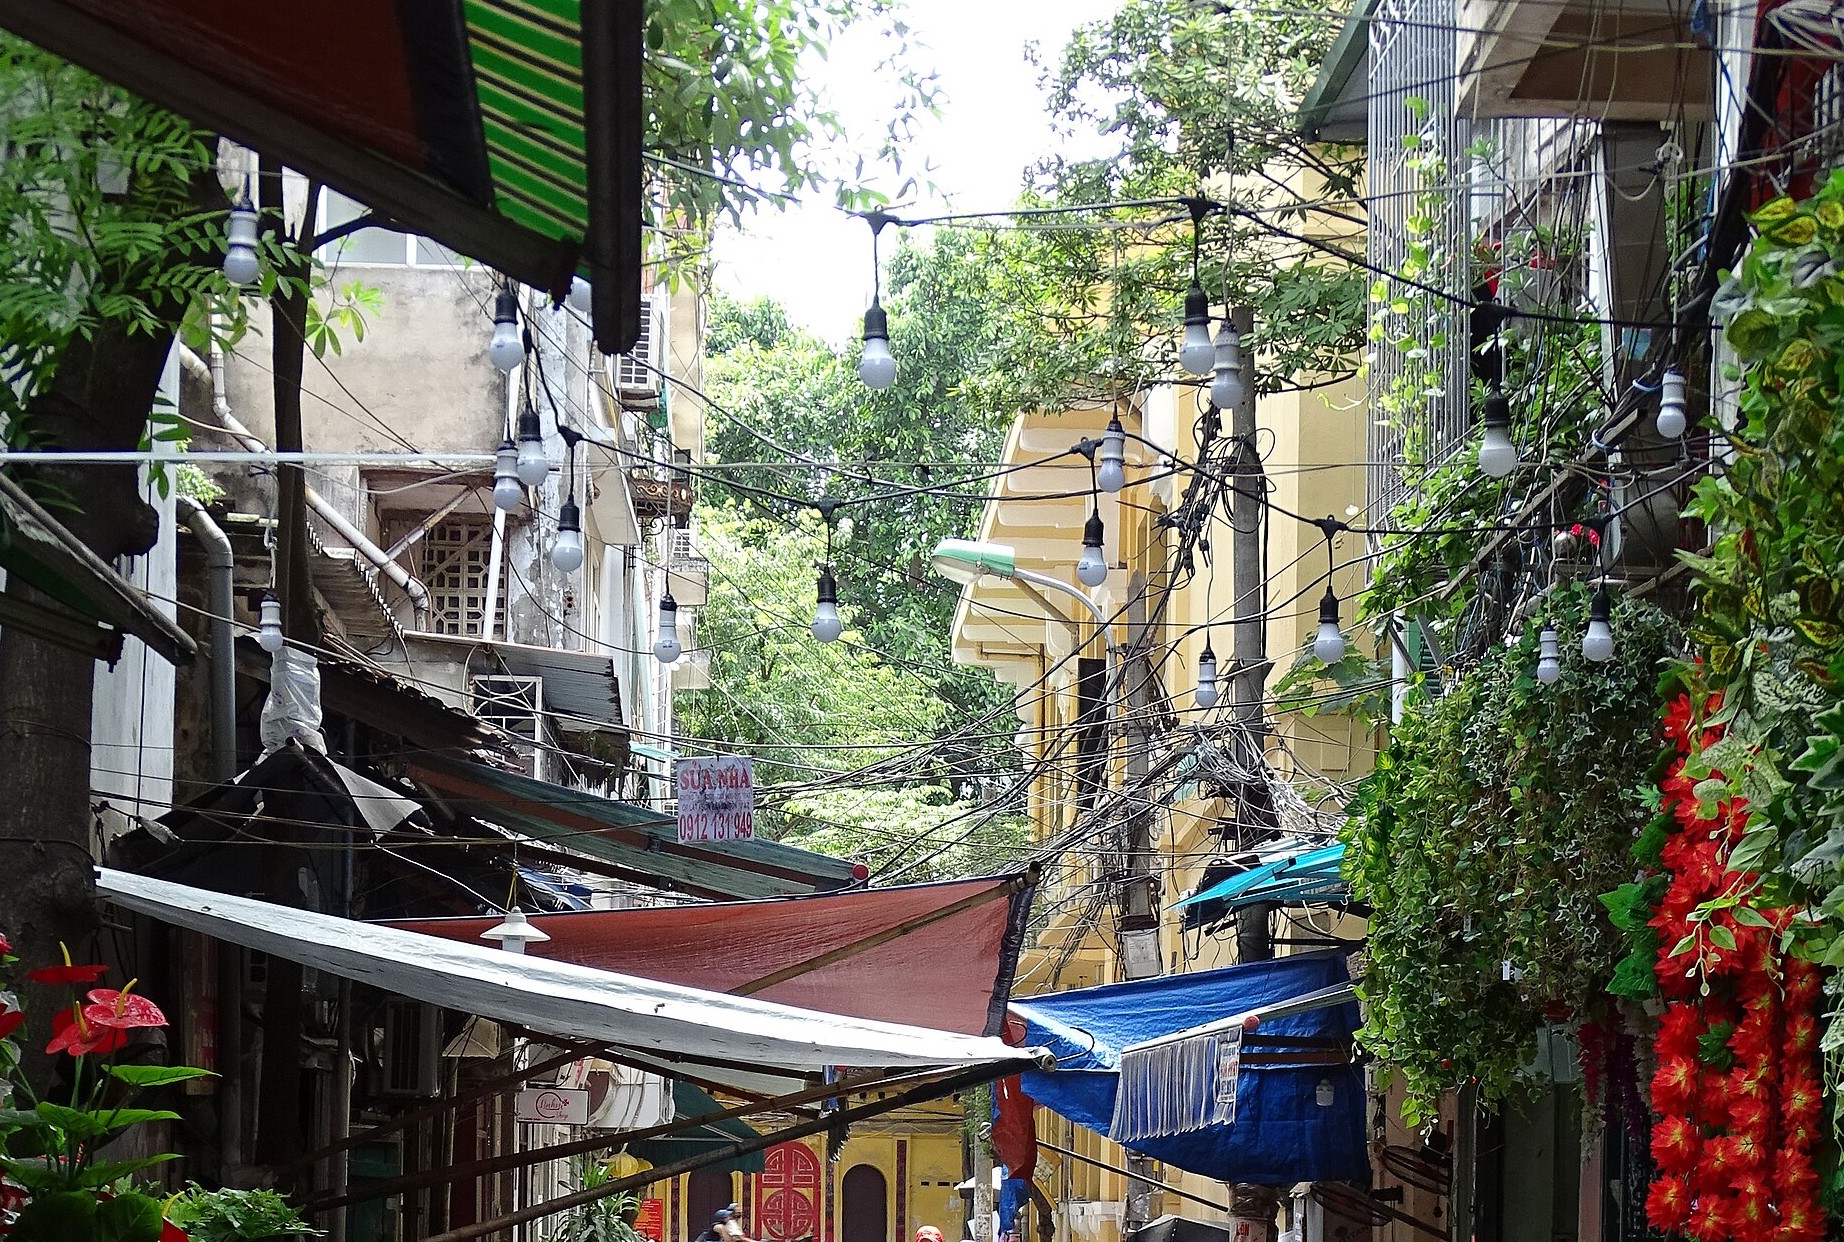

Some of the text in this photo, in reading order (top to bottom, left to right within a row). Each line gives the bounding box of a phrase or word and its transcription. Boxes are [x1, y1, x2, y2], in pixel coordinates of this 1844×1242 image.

[679, 811, 752, 840] 0912 131 949
